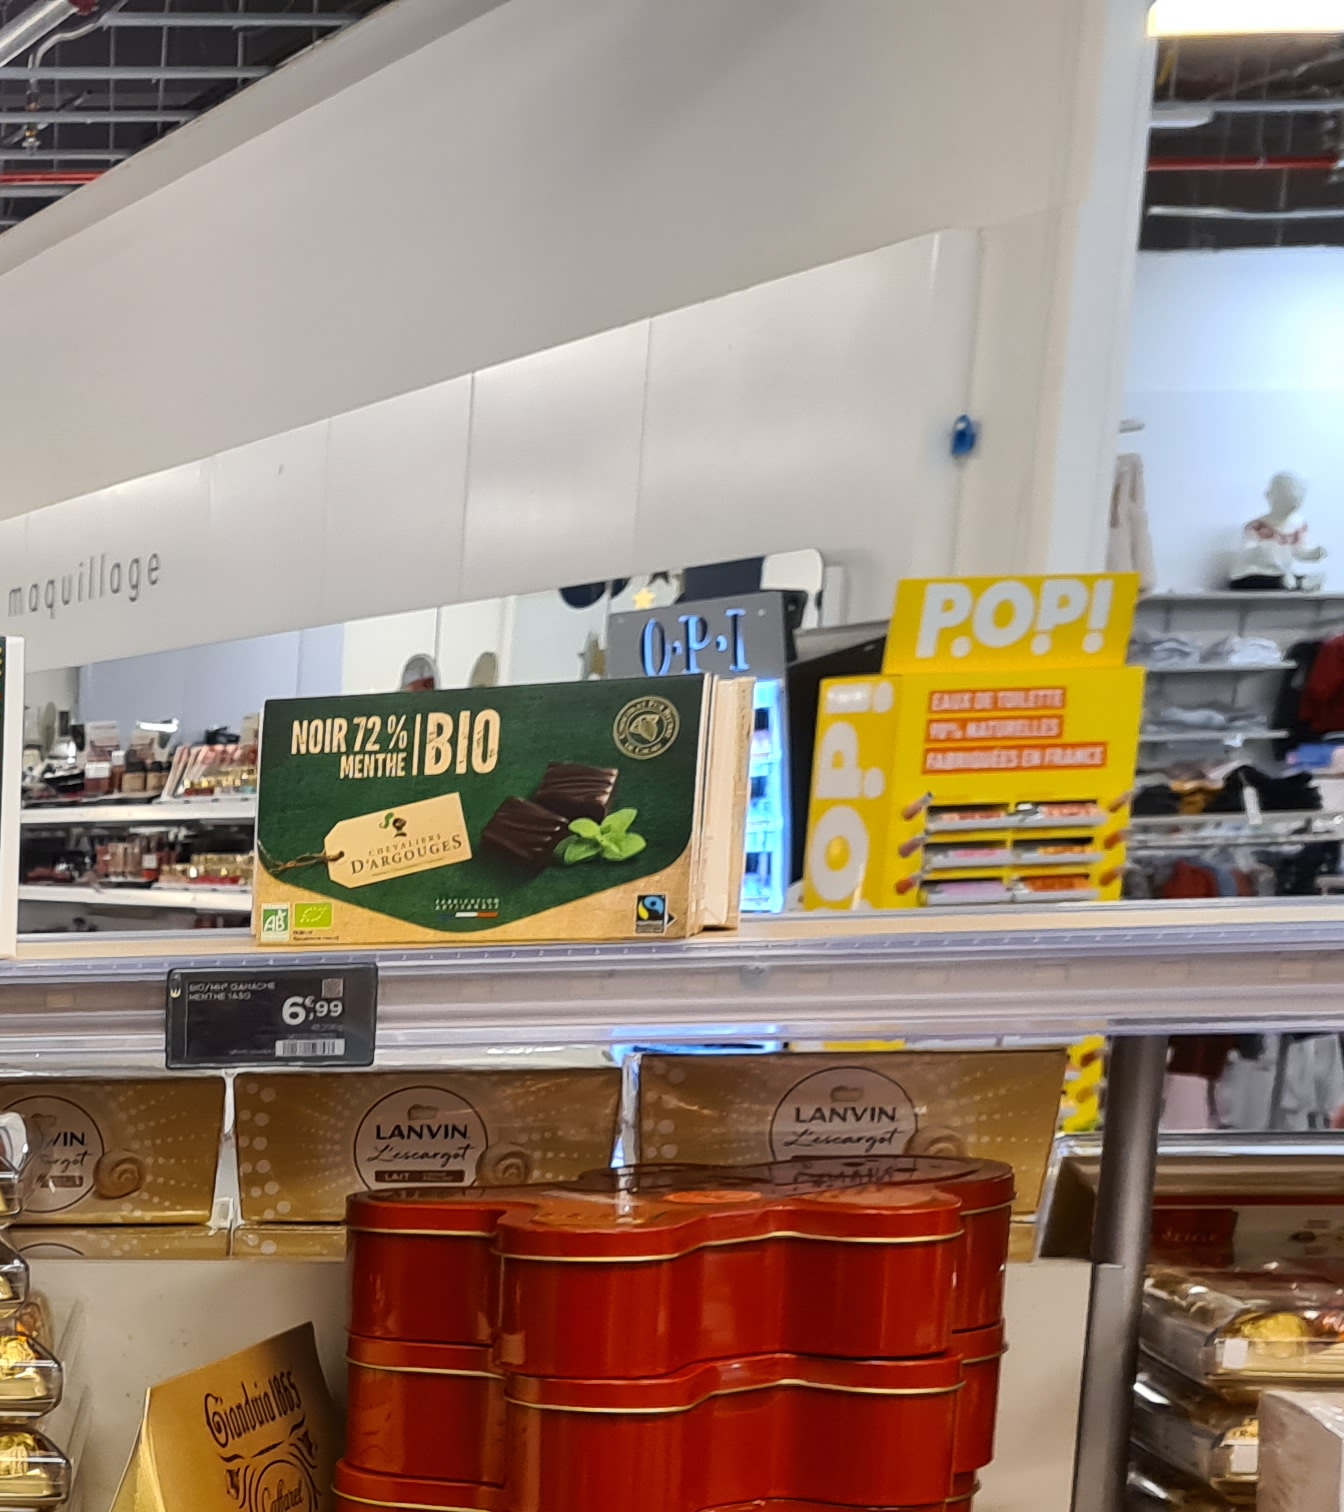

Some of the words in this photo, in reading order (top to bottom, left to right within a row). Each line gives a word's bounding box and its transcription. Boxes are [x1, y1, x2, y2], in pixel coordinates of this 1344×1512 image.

[8, 549, 161, 619] maquillage
[291, 718, 349, 756] NOIR
[353, 715, 380, 752] 72
[387, 714, 407, 750] %
[424, 709, 500, 777] BIO
[339, 752, 405, 780] MENTHE
[351, 834, 462, 874] D'ARGOUGES
[376, 1124, 468, 1140] LANVIN
[794, 1106, 897, 1124] LANVIN
